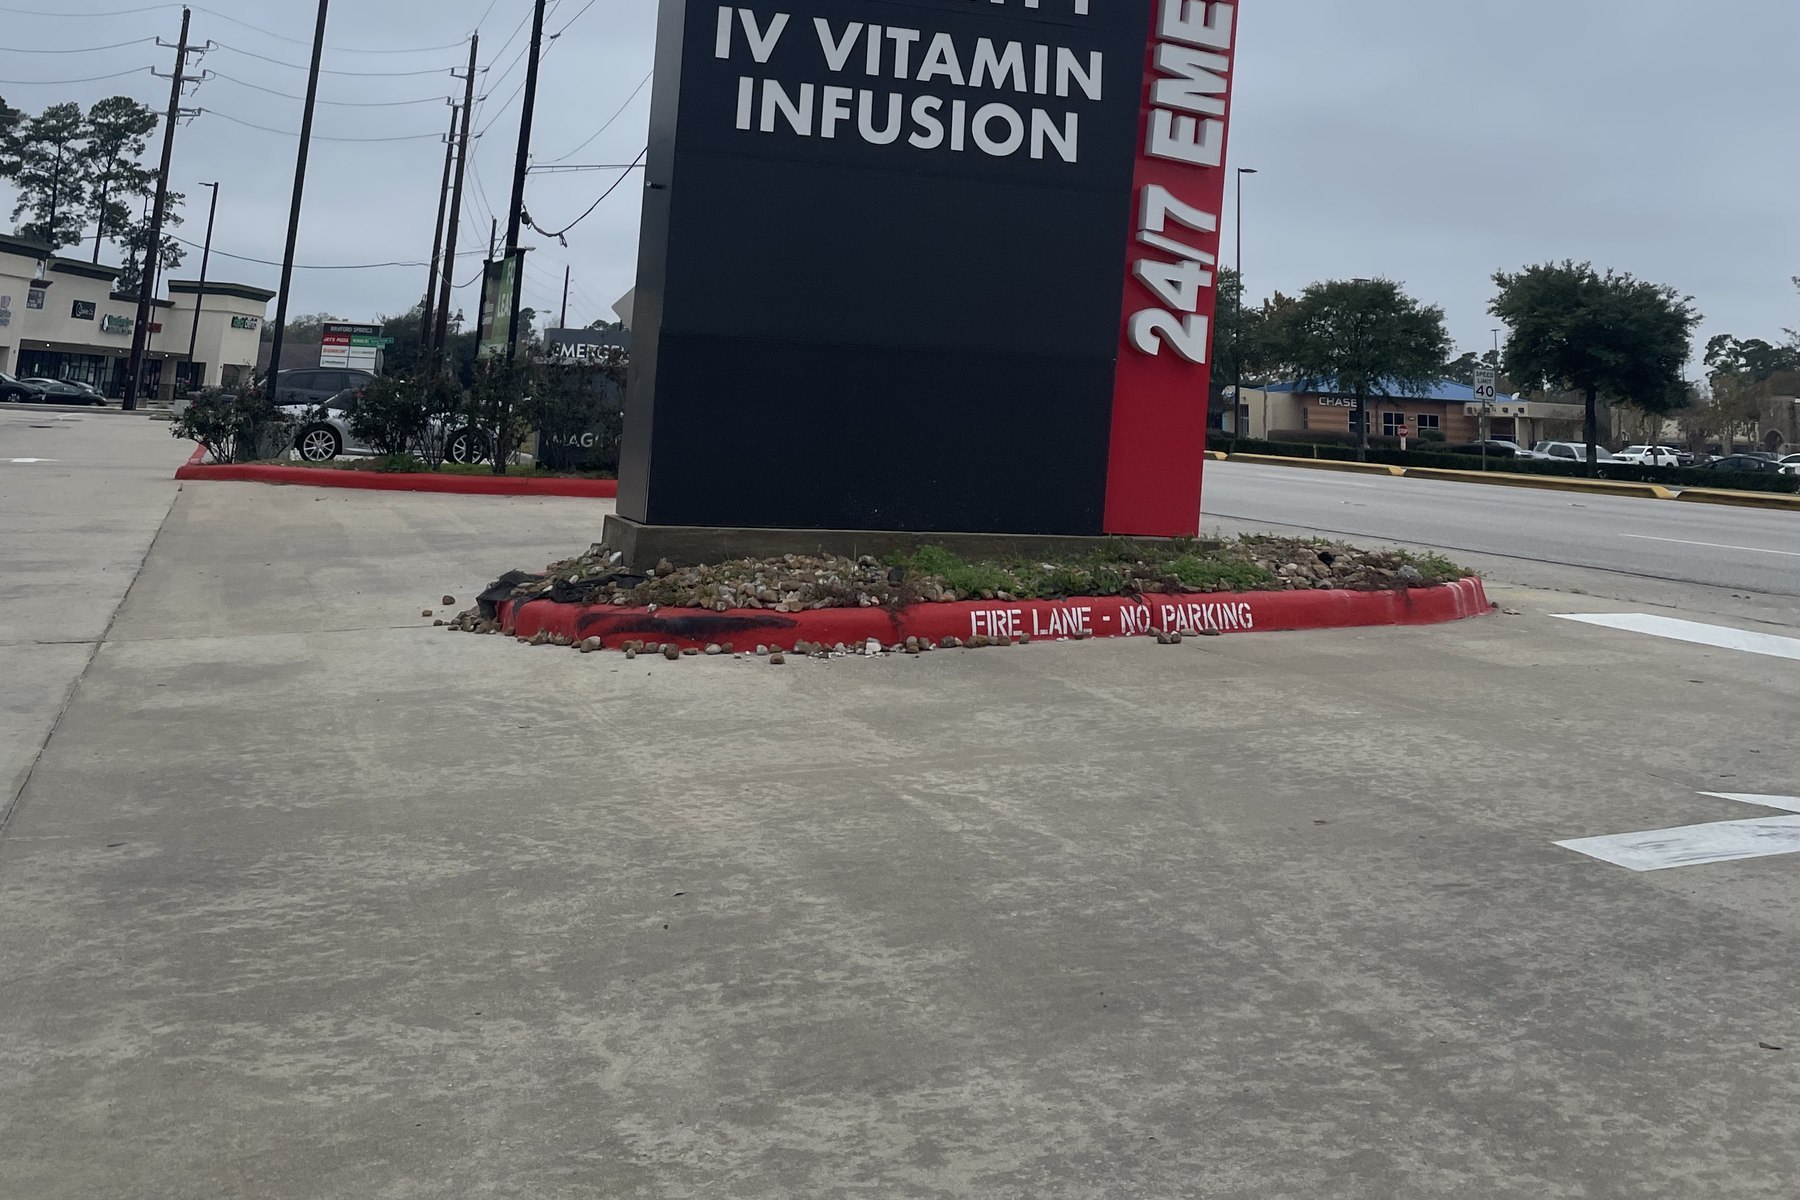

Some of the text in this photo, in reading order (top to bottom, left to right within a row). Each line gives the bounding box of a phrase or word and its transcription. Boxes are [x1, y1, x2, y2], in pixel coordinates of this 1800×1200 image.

[714, 5, 1103, 101] IV VITAMIN
[735, 76, 1079, 163] INFUSION
[1127, 182, 1218, 365] 24/7
[1318, 396, 1358, 408] CHASE
[1475, 385, 1494, 397] 40
[970, 608, 1023, 638] FIRE
[1032, 606, 1092, 637] LANE
[1120, 604, 1151, 634] NO
[1162, 601, 1254, 632] PARKING
